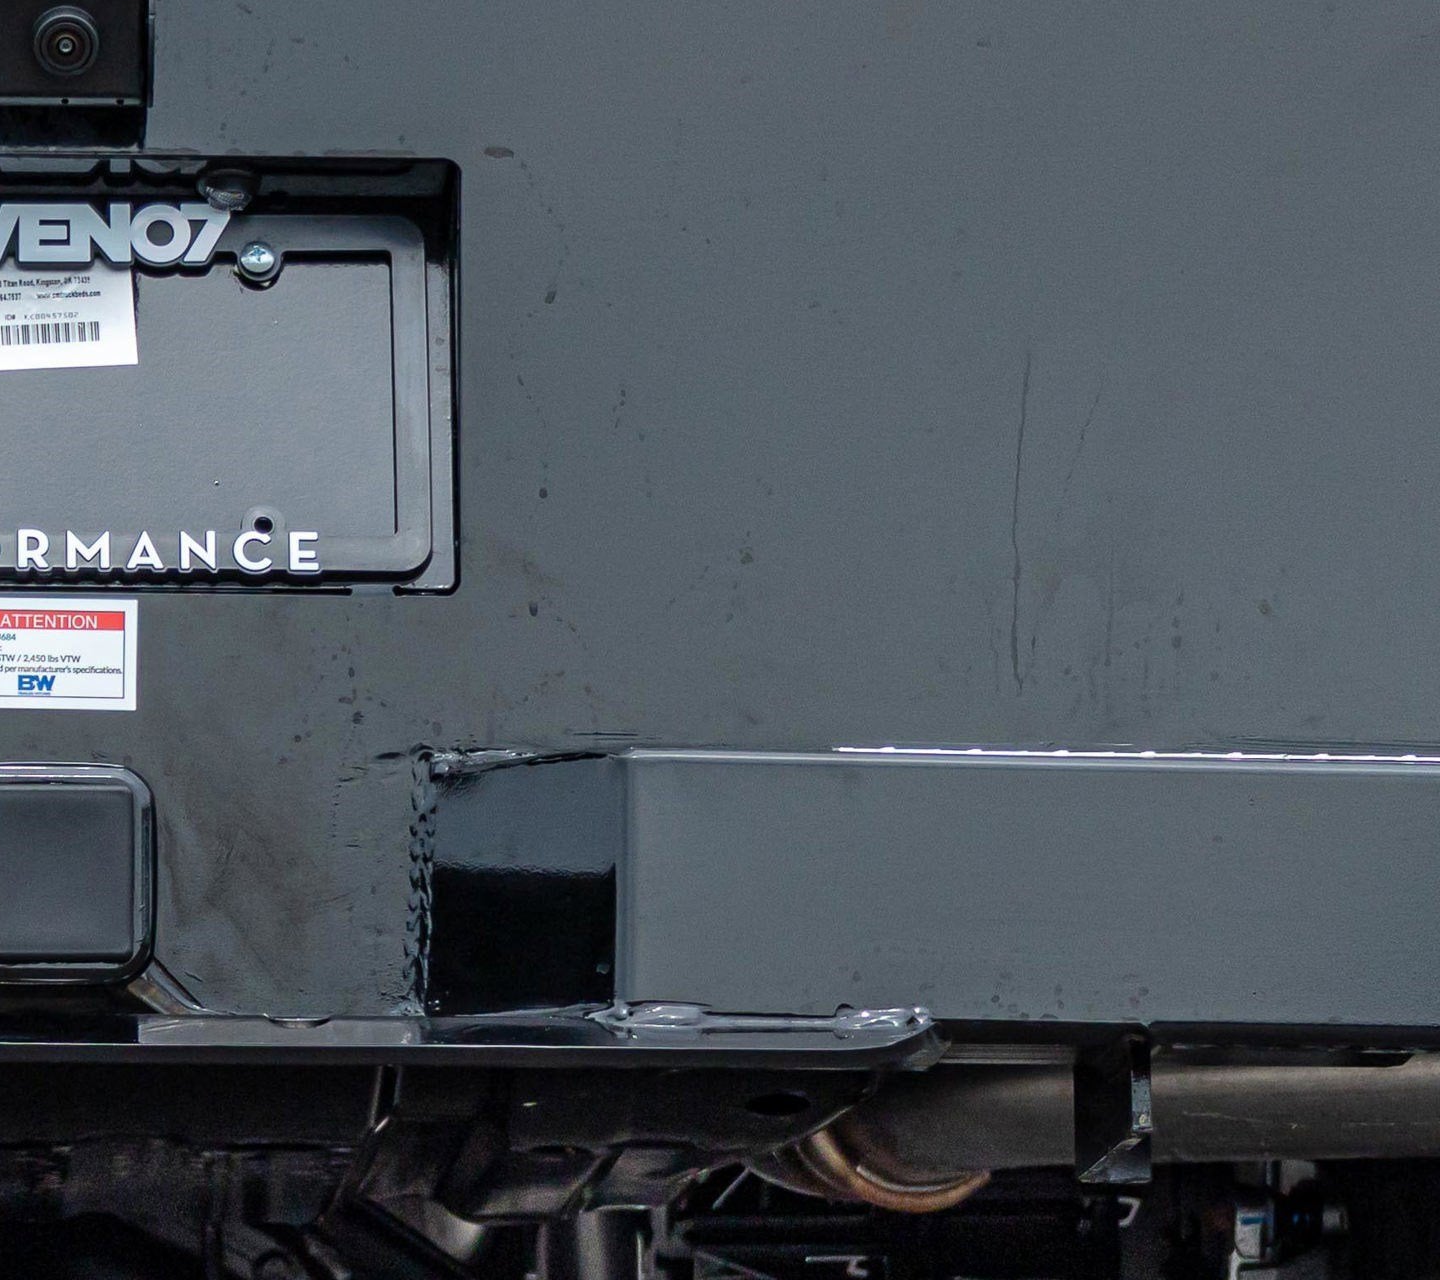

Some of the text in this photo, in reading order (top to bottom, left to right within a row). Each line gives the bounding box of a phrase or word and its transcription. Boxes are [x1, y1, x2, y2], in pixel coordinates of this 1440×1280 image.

[3, 279, 18, 288] Titan
[18, 278, 35, 288] Road,
[1, 613, 98, 630] ATTENTION
[23, 654, 47, 663] 2,450
[48, 655, 59, 663] lbs
[60, 655, 81, 663] VTW
[5, 666, 16, 674] per
[17, 665, 71, 674] manufacturer's
